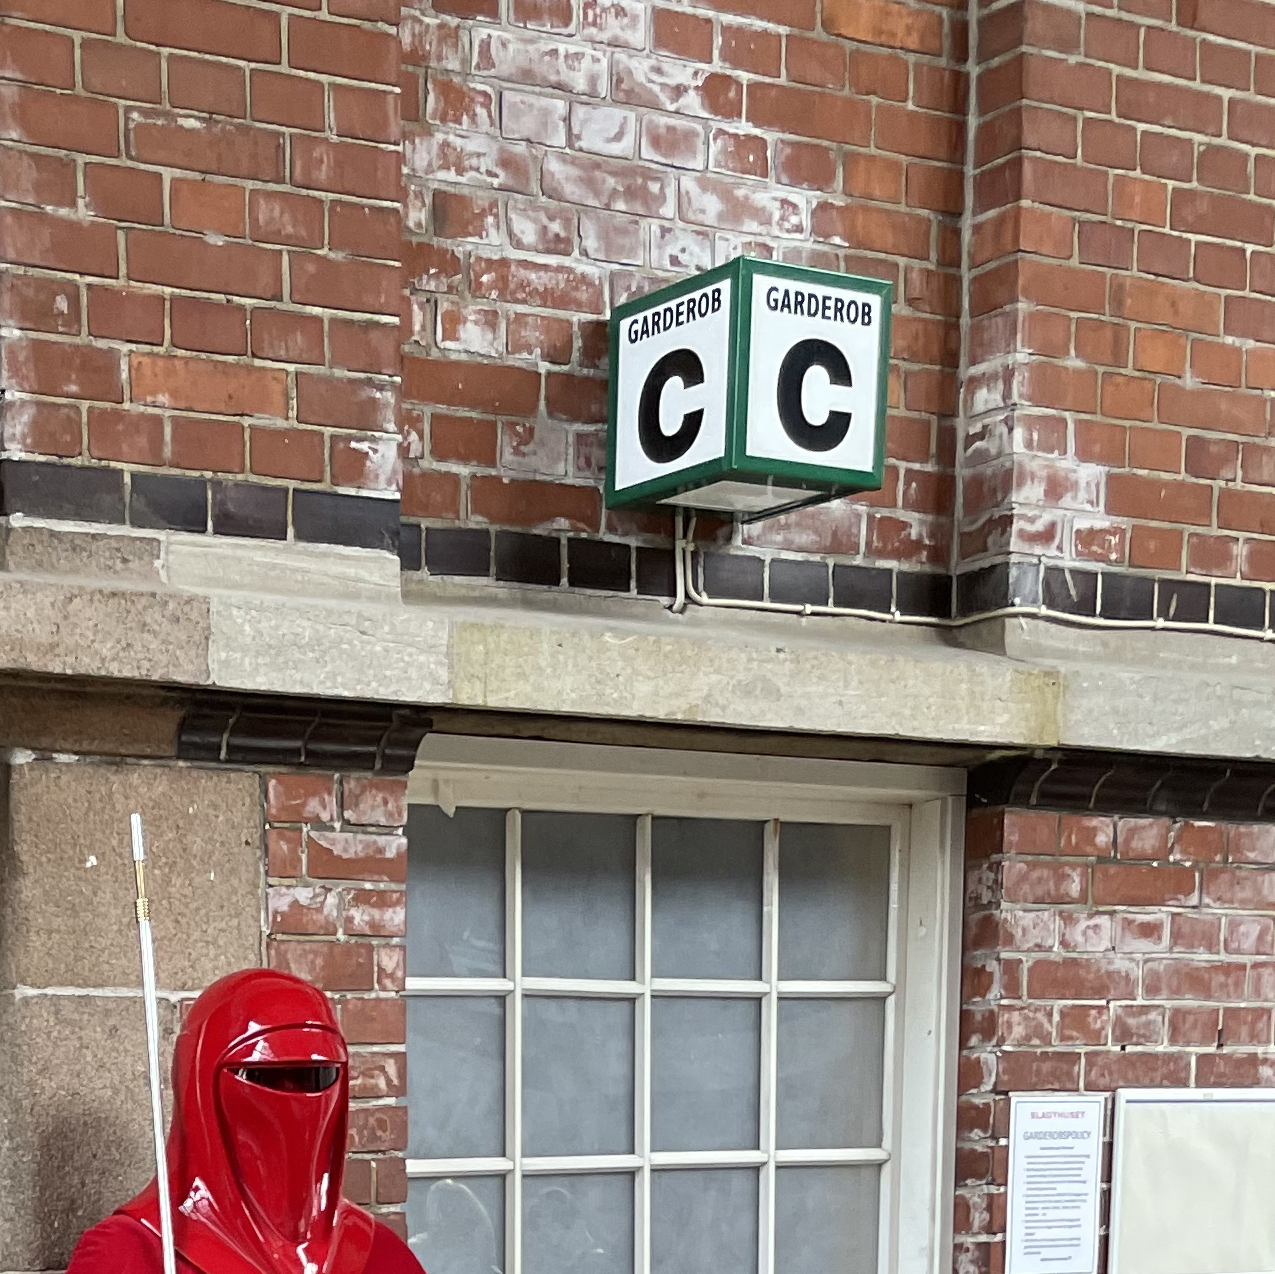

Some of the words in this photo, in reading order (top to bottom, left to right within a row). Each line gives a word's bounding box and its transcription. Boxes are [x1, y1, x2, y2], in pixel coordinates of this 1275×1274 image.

[628, 287, 722, 344] GARDEROB
[766, 286, 873, 327] GARDEROB
[638, 348, 705, 464] C
[776, 338, 853, 452] C
